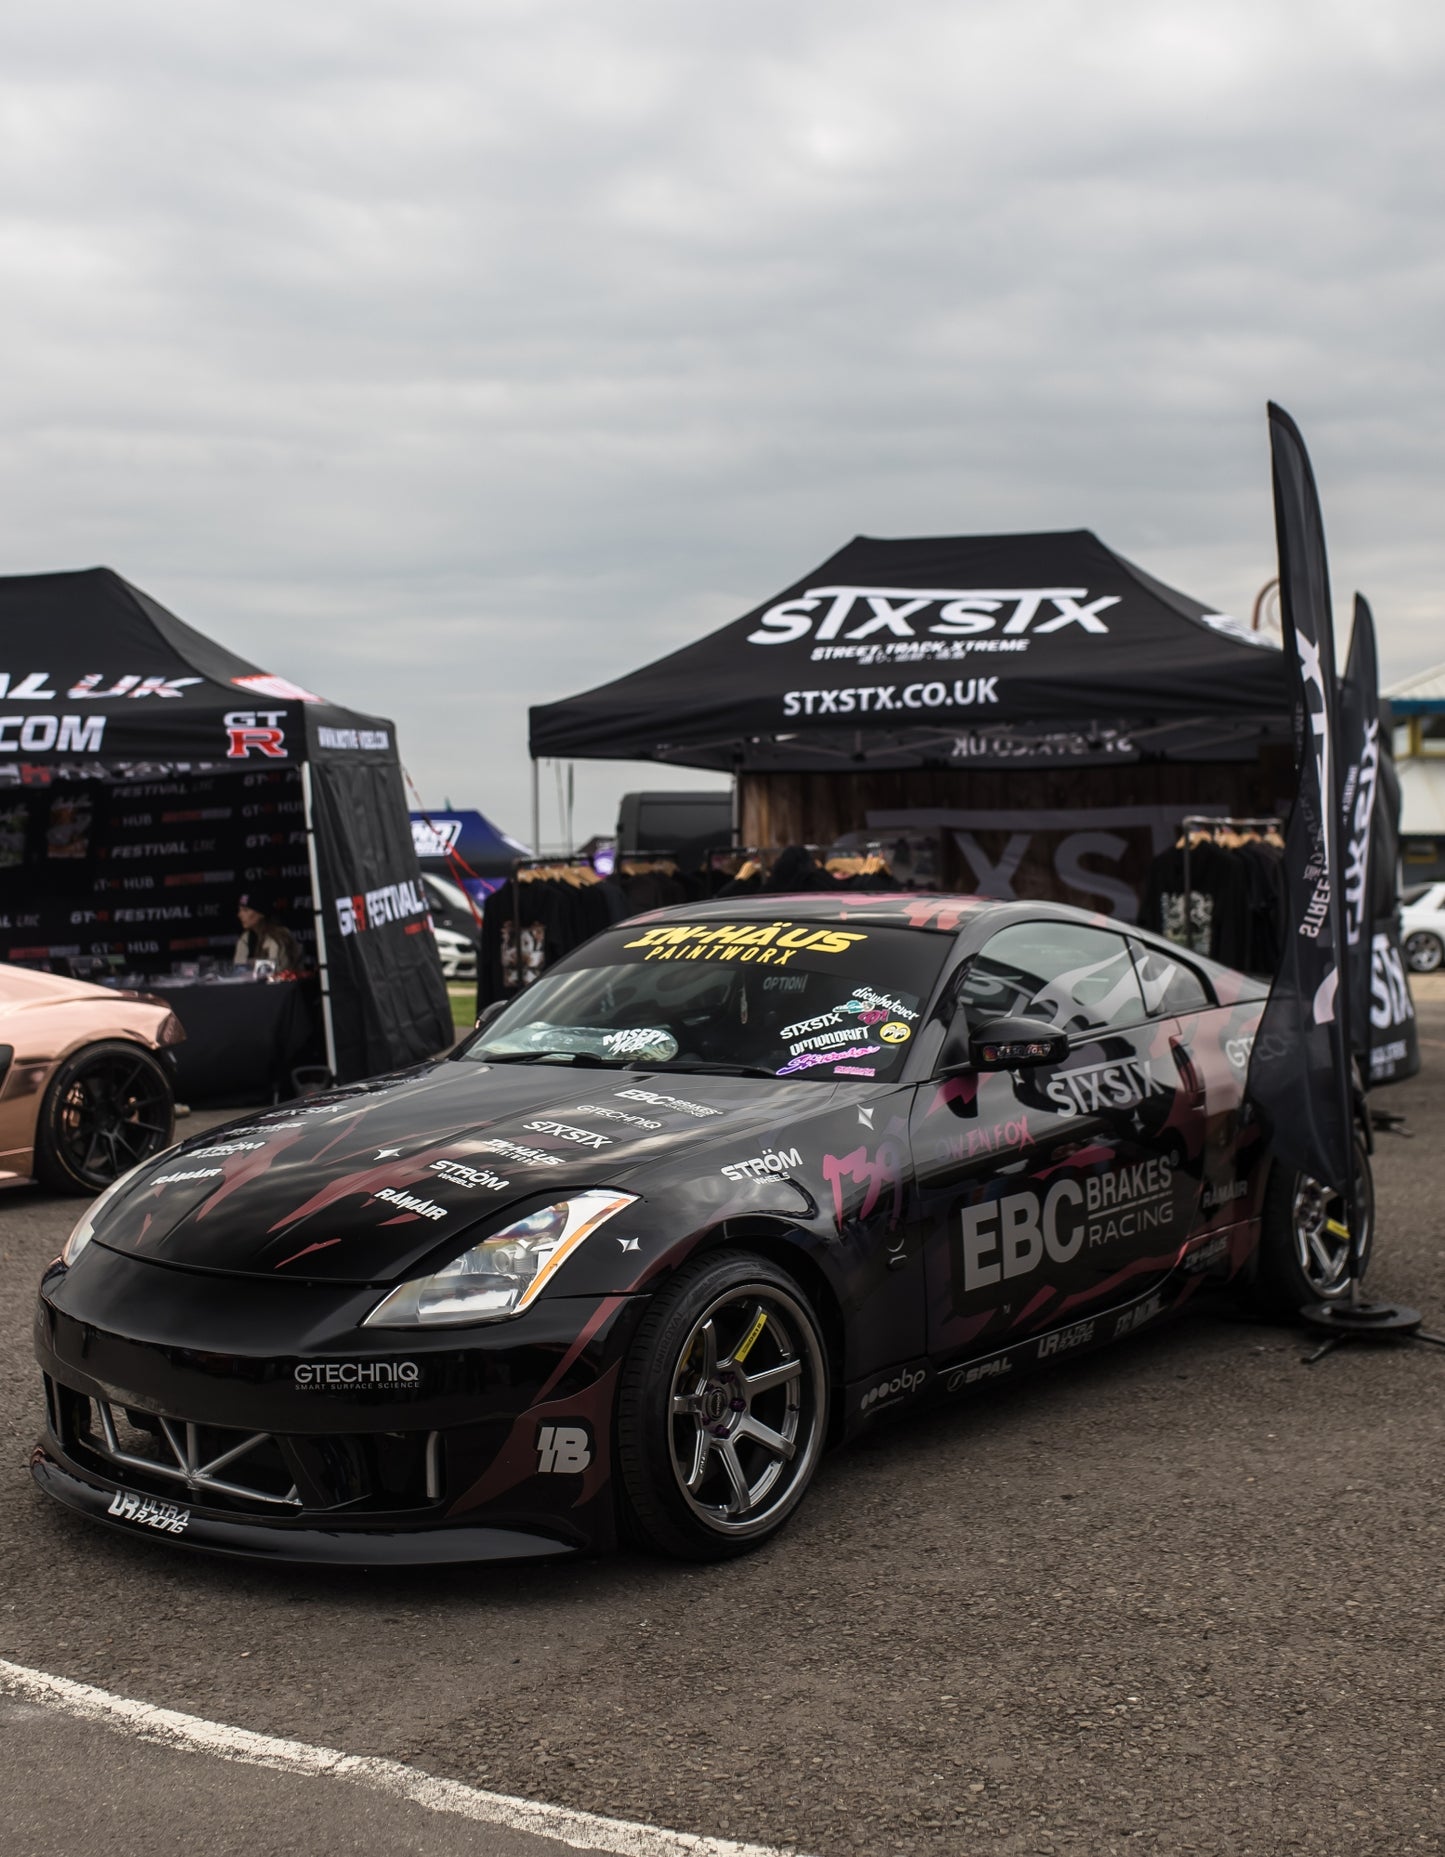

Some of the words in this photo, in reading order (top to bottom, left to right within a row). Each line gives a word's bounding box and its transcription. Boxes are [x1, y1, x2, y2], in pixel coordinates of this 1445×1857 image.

[745, 584, 1123, 646] STXSTX
[67, 673, 205, 699] UK
[782, 675, 1000, 717] STXSTX.CO.UK
[223, 710, 288, 728] GT
[226, 726, 289, 758] R
[111, 841, 190, 860] FESTIVAL
[113, 904, 193, 922] FESTIVAL
[623, 921, 868, 954] IN-HÄUS
[644, 945, 798, 966] PAINTWORX
[779, 1012, 844, 1040] STXSTX
[613, 1088, 676, 1105] EBC
[1046, 1056, 1166, 1119] STXSTX
[523, 1120, 613, 1149] STXSTX
[993, 1113, 1036, 1152] FOX
[429, 1159, 510, 1191] STRÖM
[720, 1147, 805, 1182] STRÖM
[752, 1171, 791, 1186] WHEELS
[373, 1188, 449, 1221] RAMAIR
[960, 1178, 1086, 1292] EBC
[1085, 1154, 1173, 1212] BRAKES
[1088, 1201, 1174, 1249] RACING
[294, 1383, 326, 1391] SMART
[330, 1382, 374, 1391] SURFACE
[377, 1381, 420, 1389] SCIENCE
[131, 1508, 190, 1534] RACING
[141, 1497, 191, 1523] ULTRA
